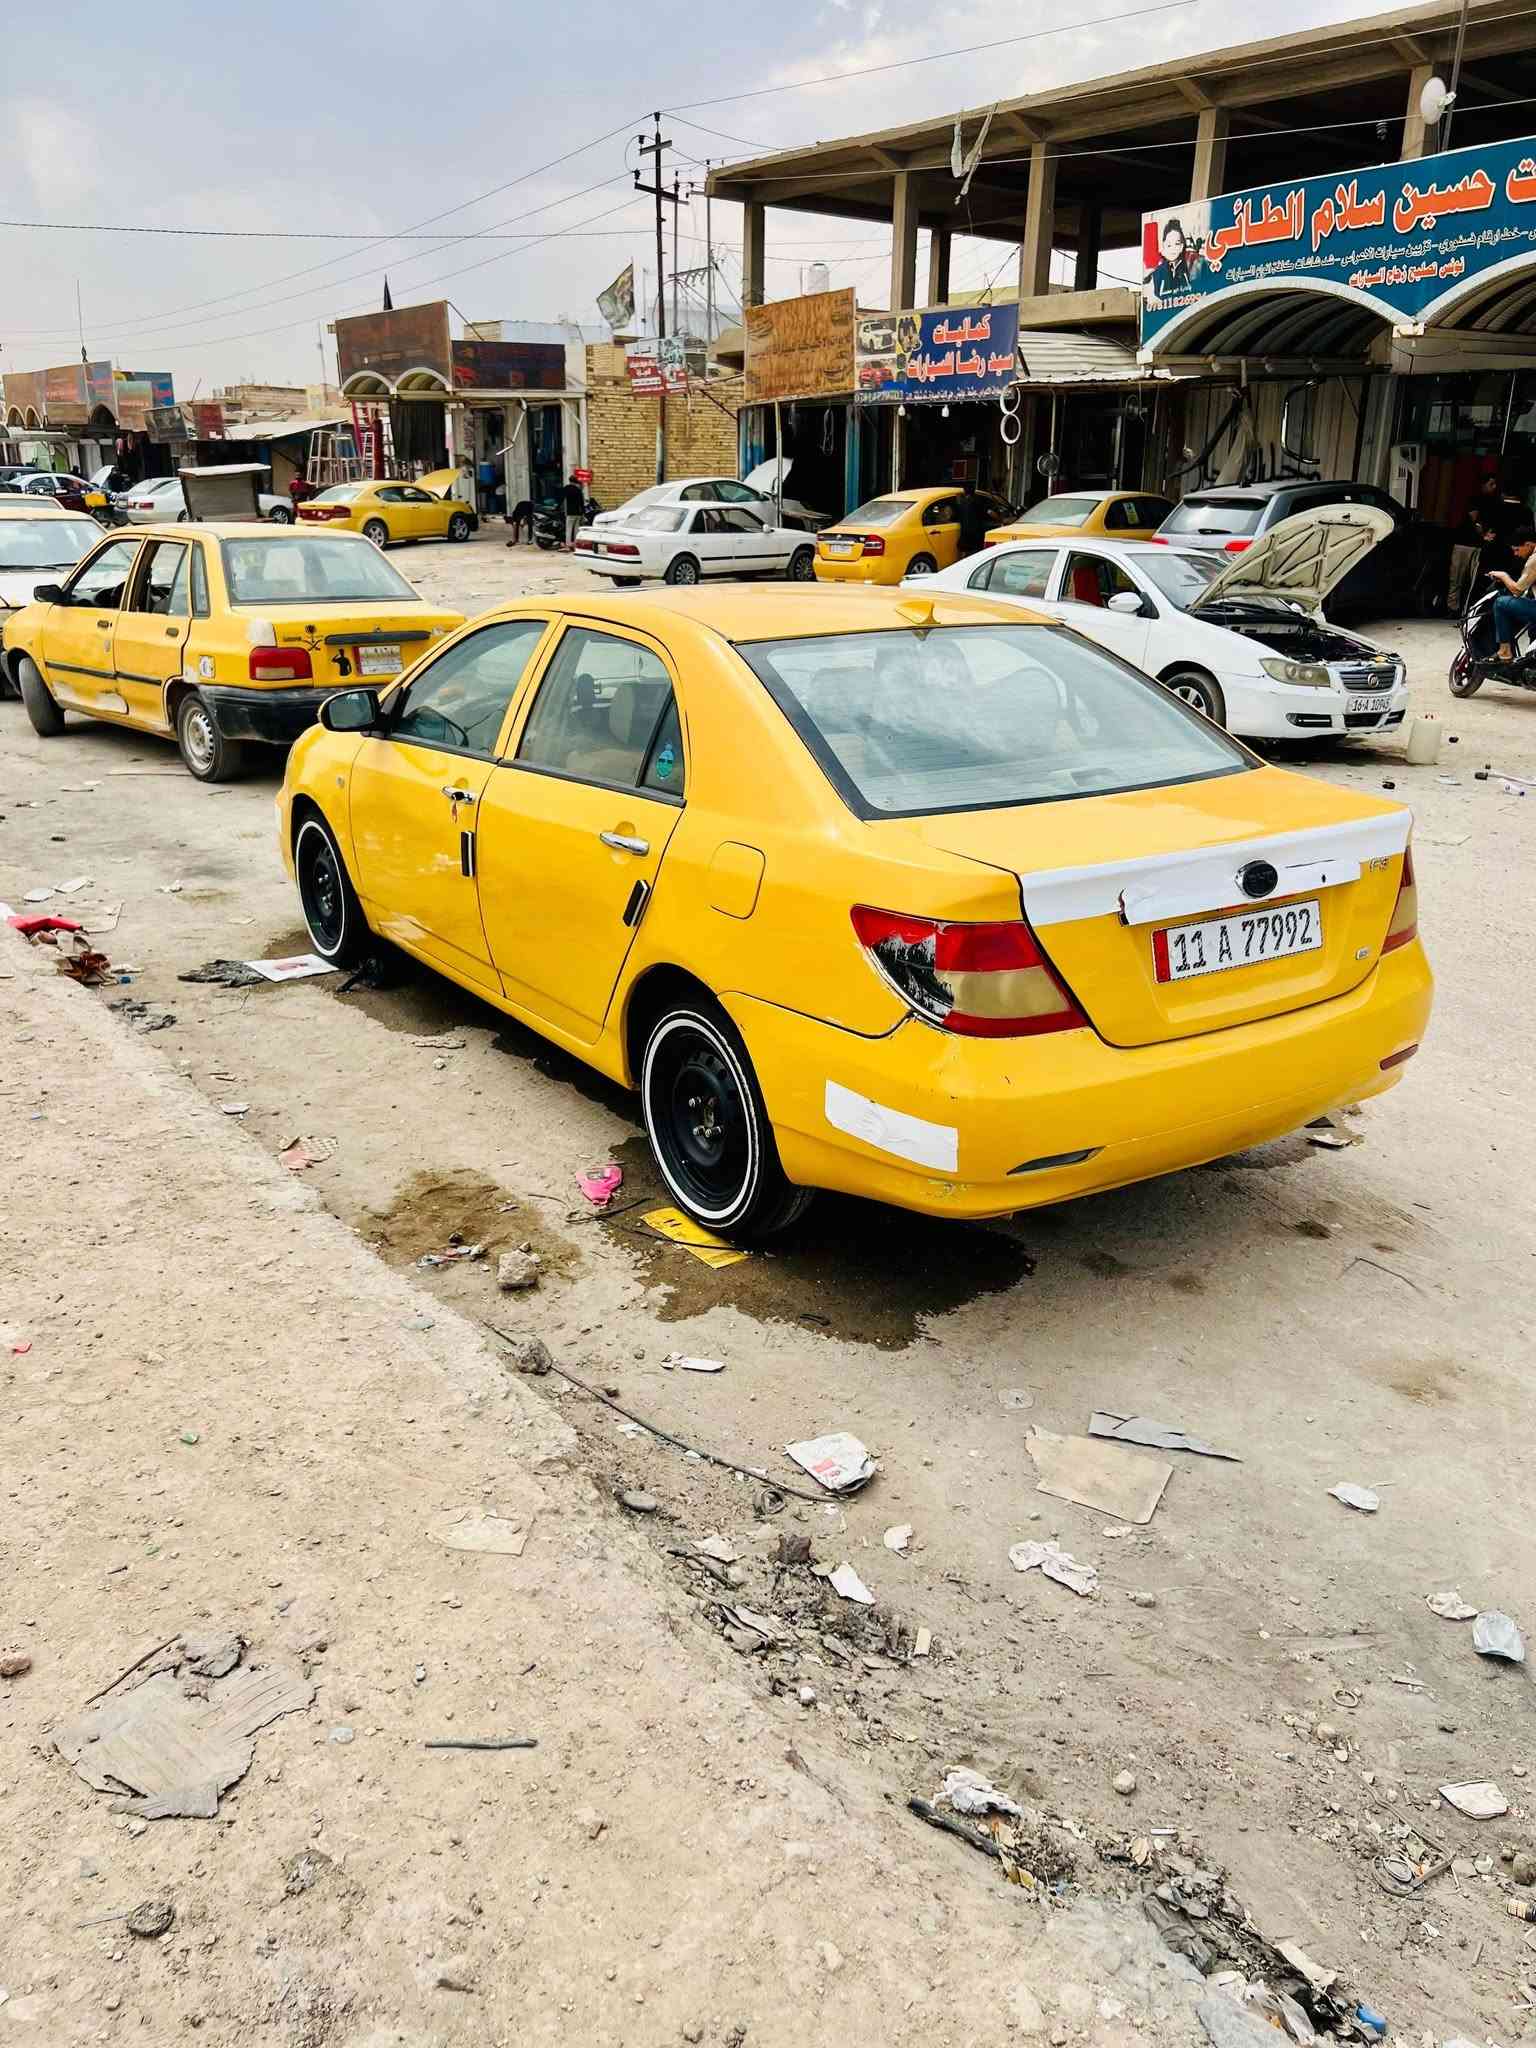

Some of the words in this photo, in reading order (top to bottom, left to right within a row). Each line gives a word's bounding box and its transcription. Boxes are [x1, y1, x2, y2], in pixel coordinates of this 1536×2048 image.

[1204, 188, 1305, 272] الطائي
[1312, 179, 1385, 252] سلام
[1394, 168, 1497, 233] حسين
[933, 314, 991, 347] كماليات
[956, 349, 986, 378] رضا
[987, 352, 1014, 376] سيد
[1174, 930, 1207, 972] 11
[1218, 924, 1234, 962] A
[1242, 907, 1313, 958] 77992
